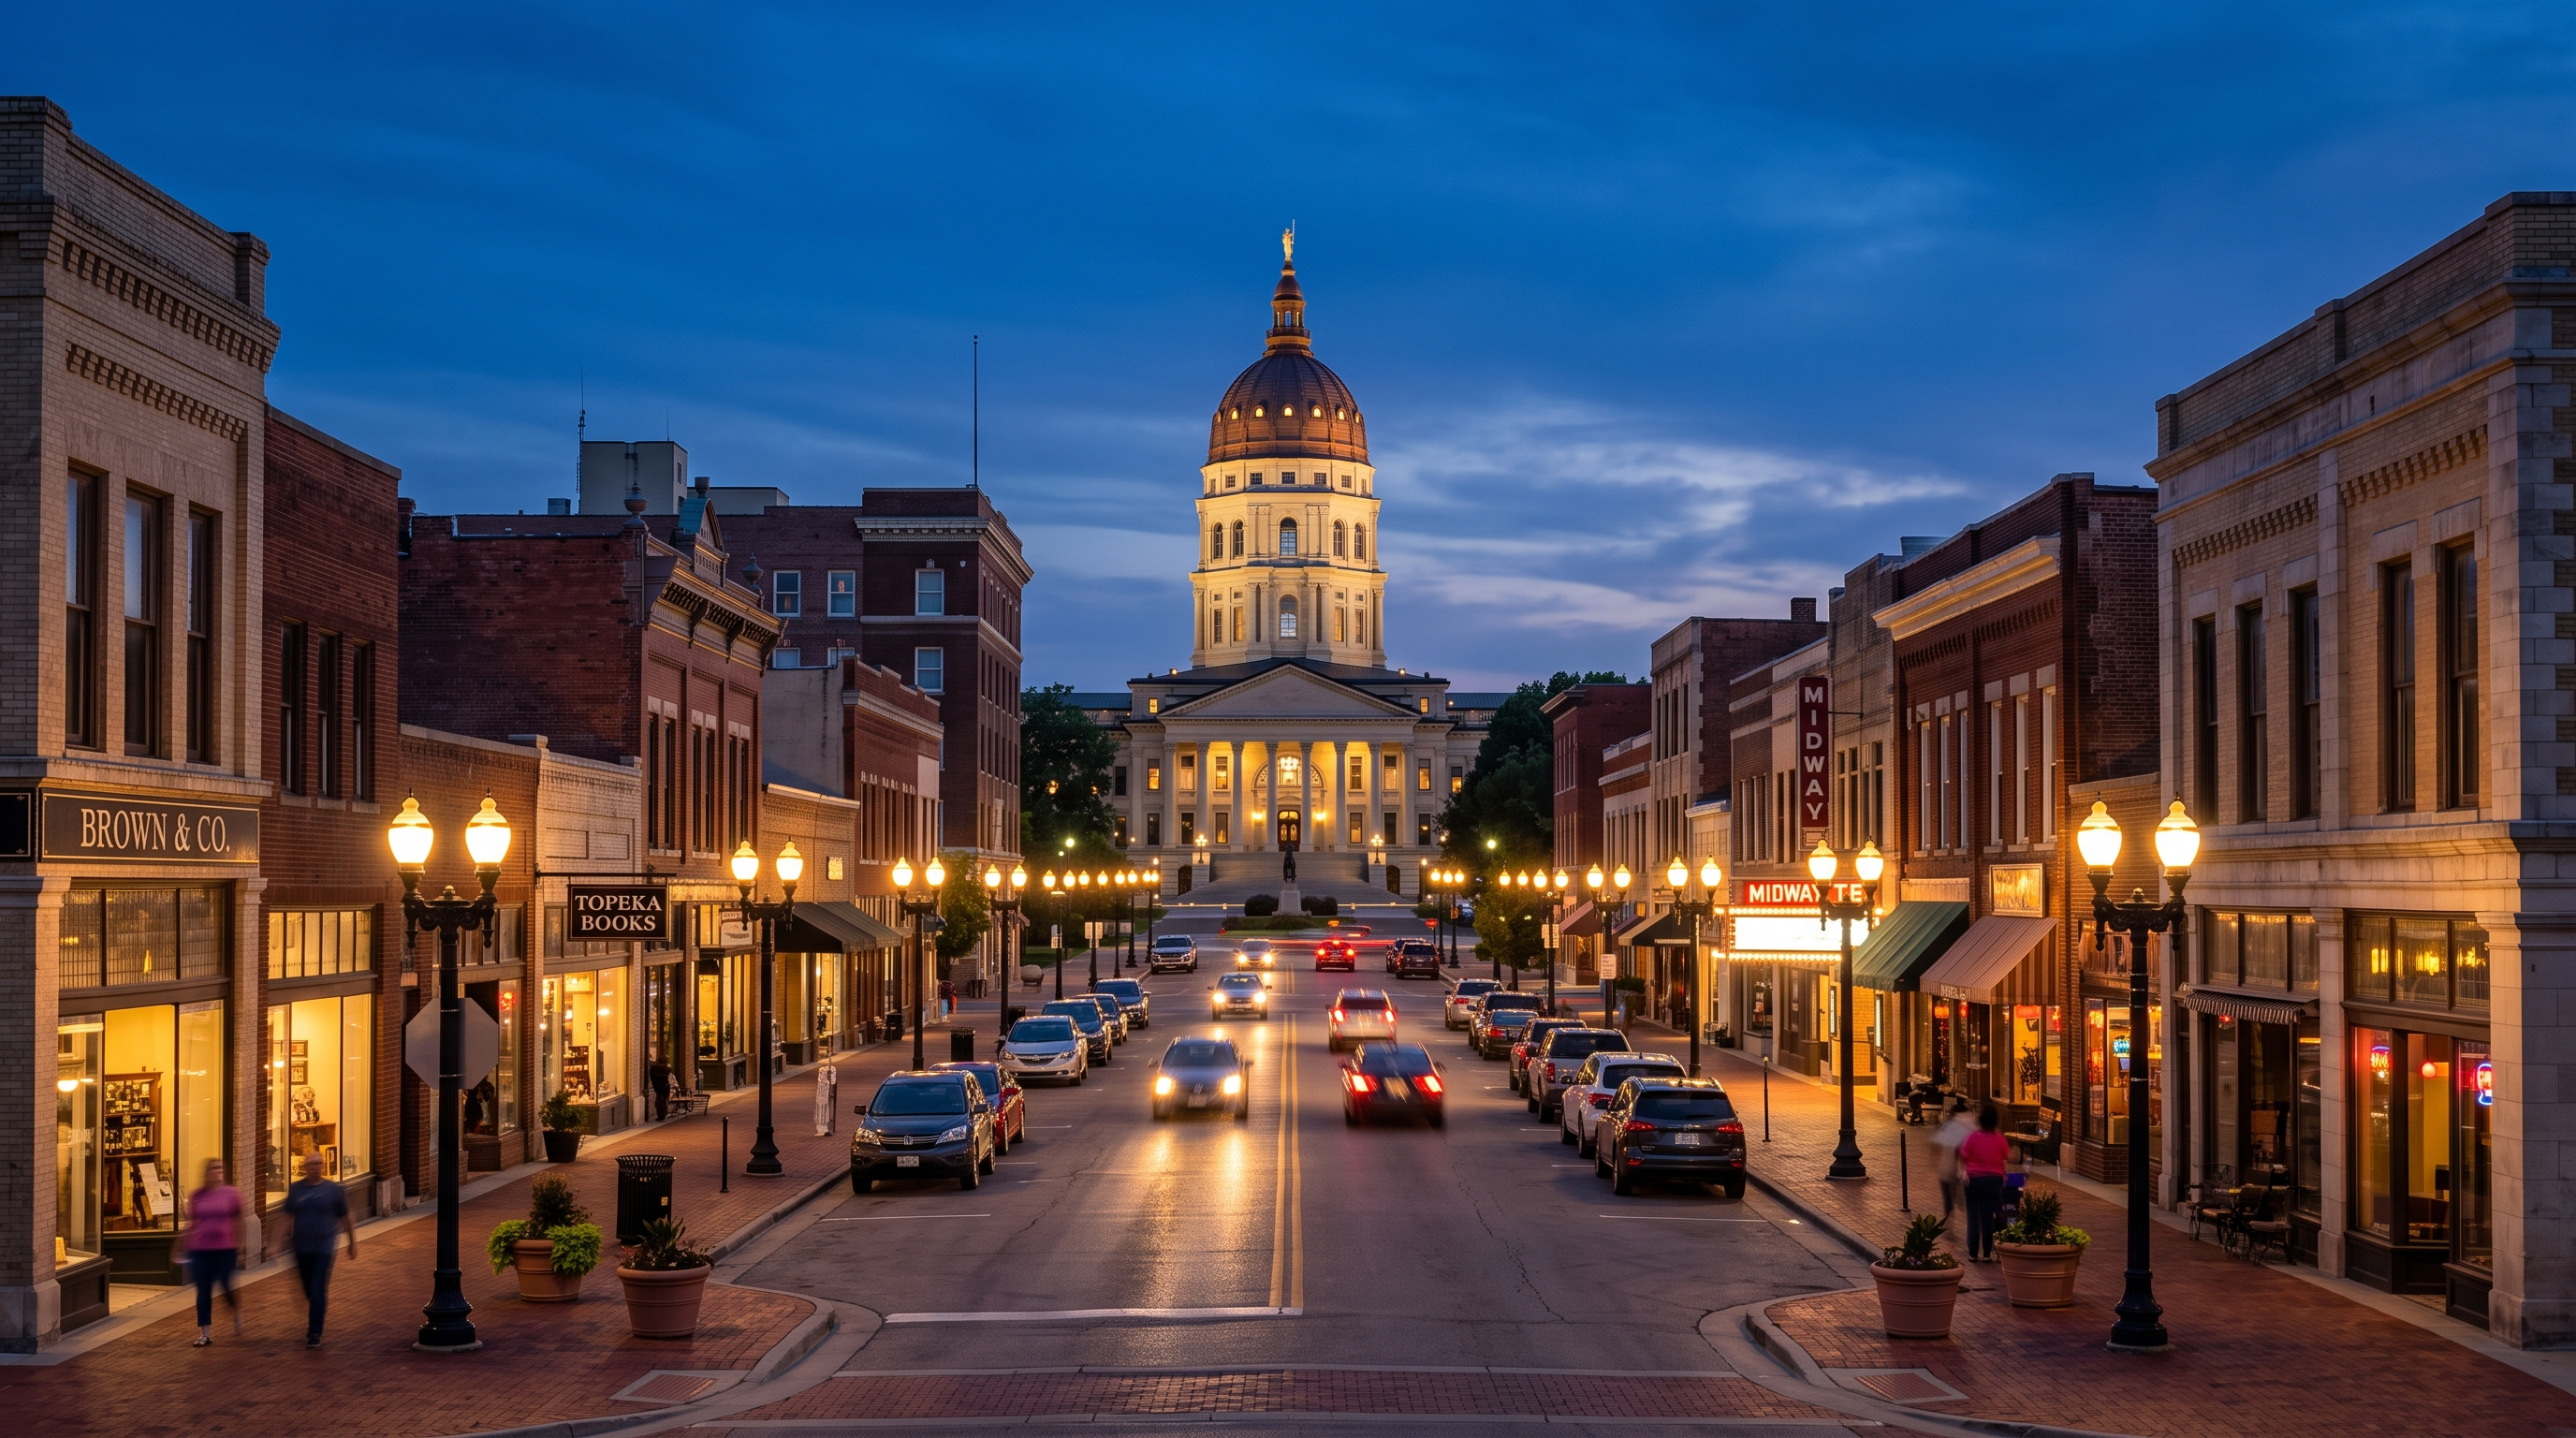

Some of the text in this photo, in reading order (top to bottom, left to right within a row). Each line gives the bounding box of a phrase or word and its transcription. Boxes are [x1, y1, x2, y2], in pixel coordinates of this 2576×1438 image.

[1804, 686, 1825, 820] MIDWAY
[80, 808, 230, 853] BROWN & CO.
[1749, 884, 1822, 902] MIDWAY
[575, 895, 663, 911] TOPEKA
[580, 915, 656, 932] BOOKS
